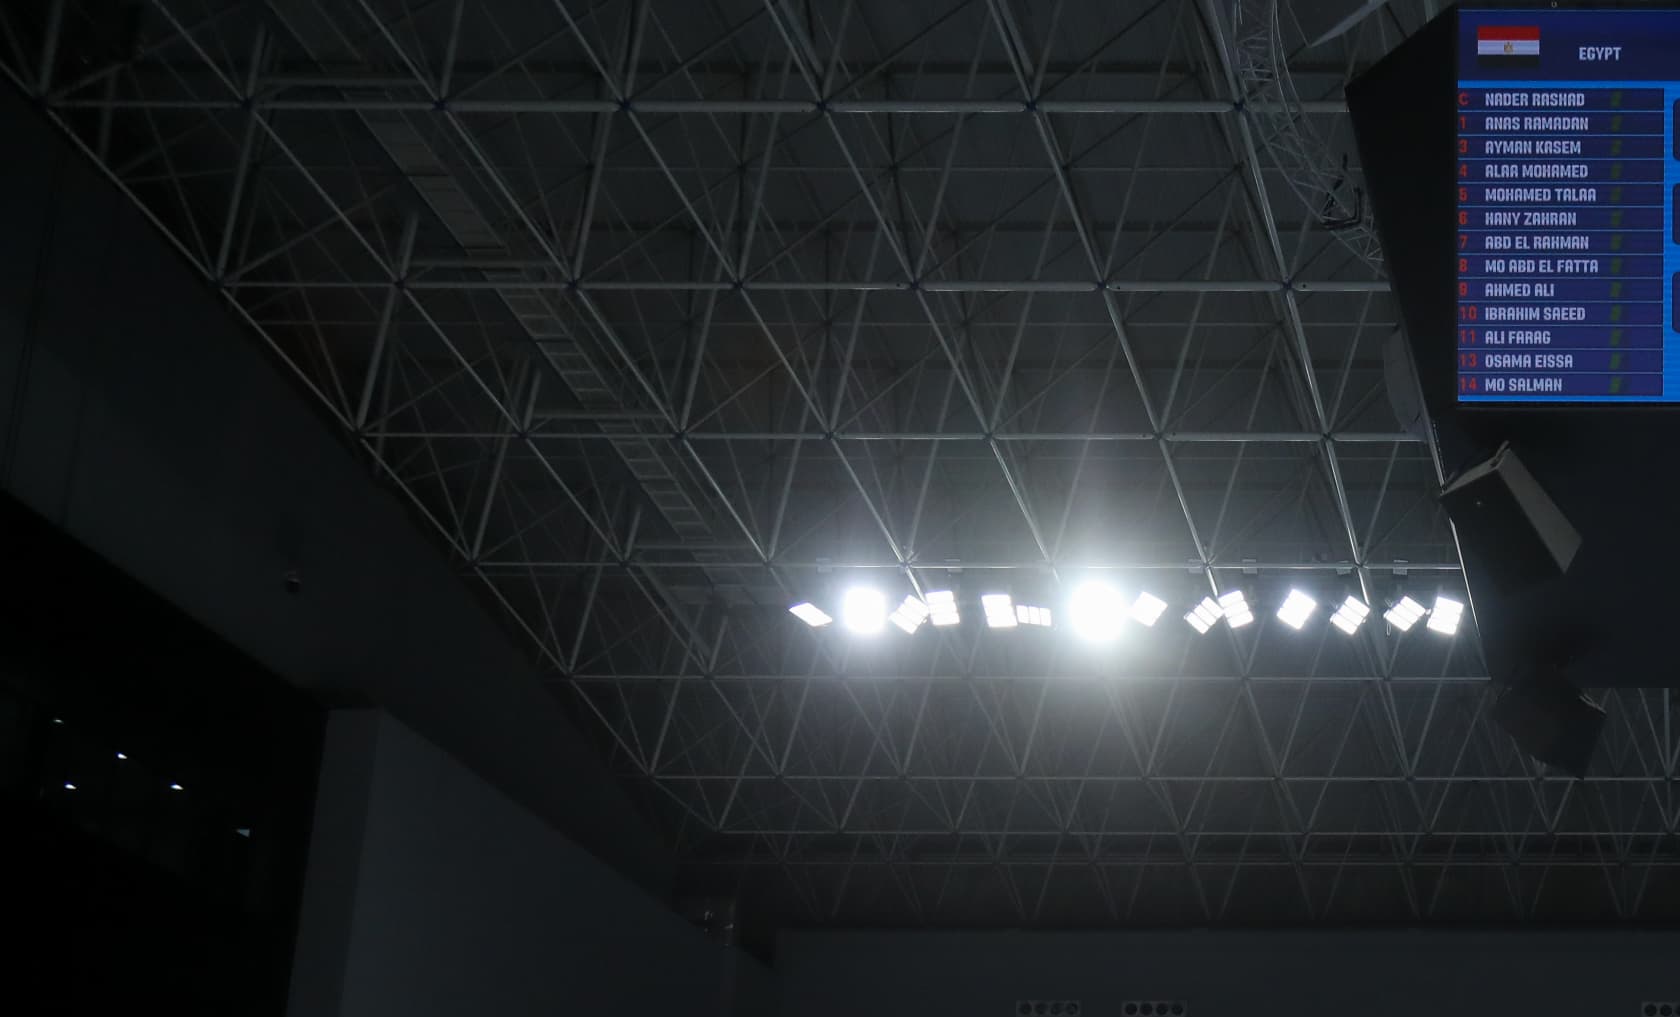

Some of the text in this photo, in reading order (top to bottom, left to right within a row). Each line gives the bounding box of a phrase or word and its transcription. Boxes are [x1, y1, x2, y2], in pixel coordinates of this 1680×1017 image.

[1578, 46, 1622, 62] EGYPT
[1458, 93, 1585, 106] C NADER RASHAD
[1459, 117, 1589, 130] 1 ANAS RAMADAN
[1458, 140, 1581, 154] 3 AYMAN KASEM
[1458, 164, 1588, 178] 4 ALAA MOHAMED
[1485, 188, 1551, 202] MOHAMED
[1555, 188, 1596, 202] TALAA
[1485, 212, 1521, 226] HANY
[1524, 212, 1577, 226] ZAHRAN
[1459, 235, 1589, 250] 7 ABD EL RAHMAN
[1485, 260, 1505, 273] MO
[1509, 260, 1535, 273] ABD
[1539, 260, 1554, 273] EL
[1557, 260, 1598, 273] FATTA
[1485, 284, 1531, 297] AHMED
[1534, 284, 1554, 297] ALI
[1460, 306, 1586, 320] 10 IBRAHIM SAEED
[1460, 330, 1551, 344] 11 ALI FARAG
[1460, 354, 1573, 368] 13 OSAMA EISSA
[1460, 378, 1562, 392] 14 MO SALMAN
